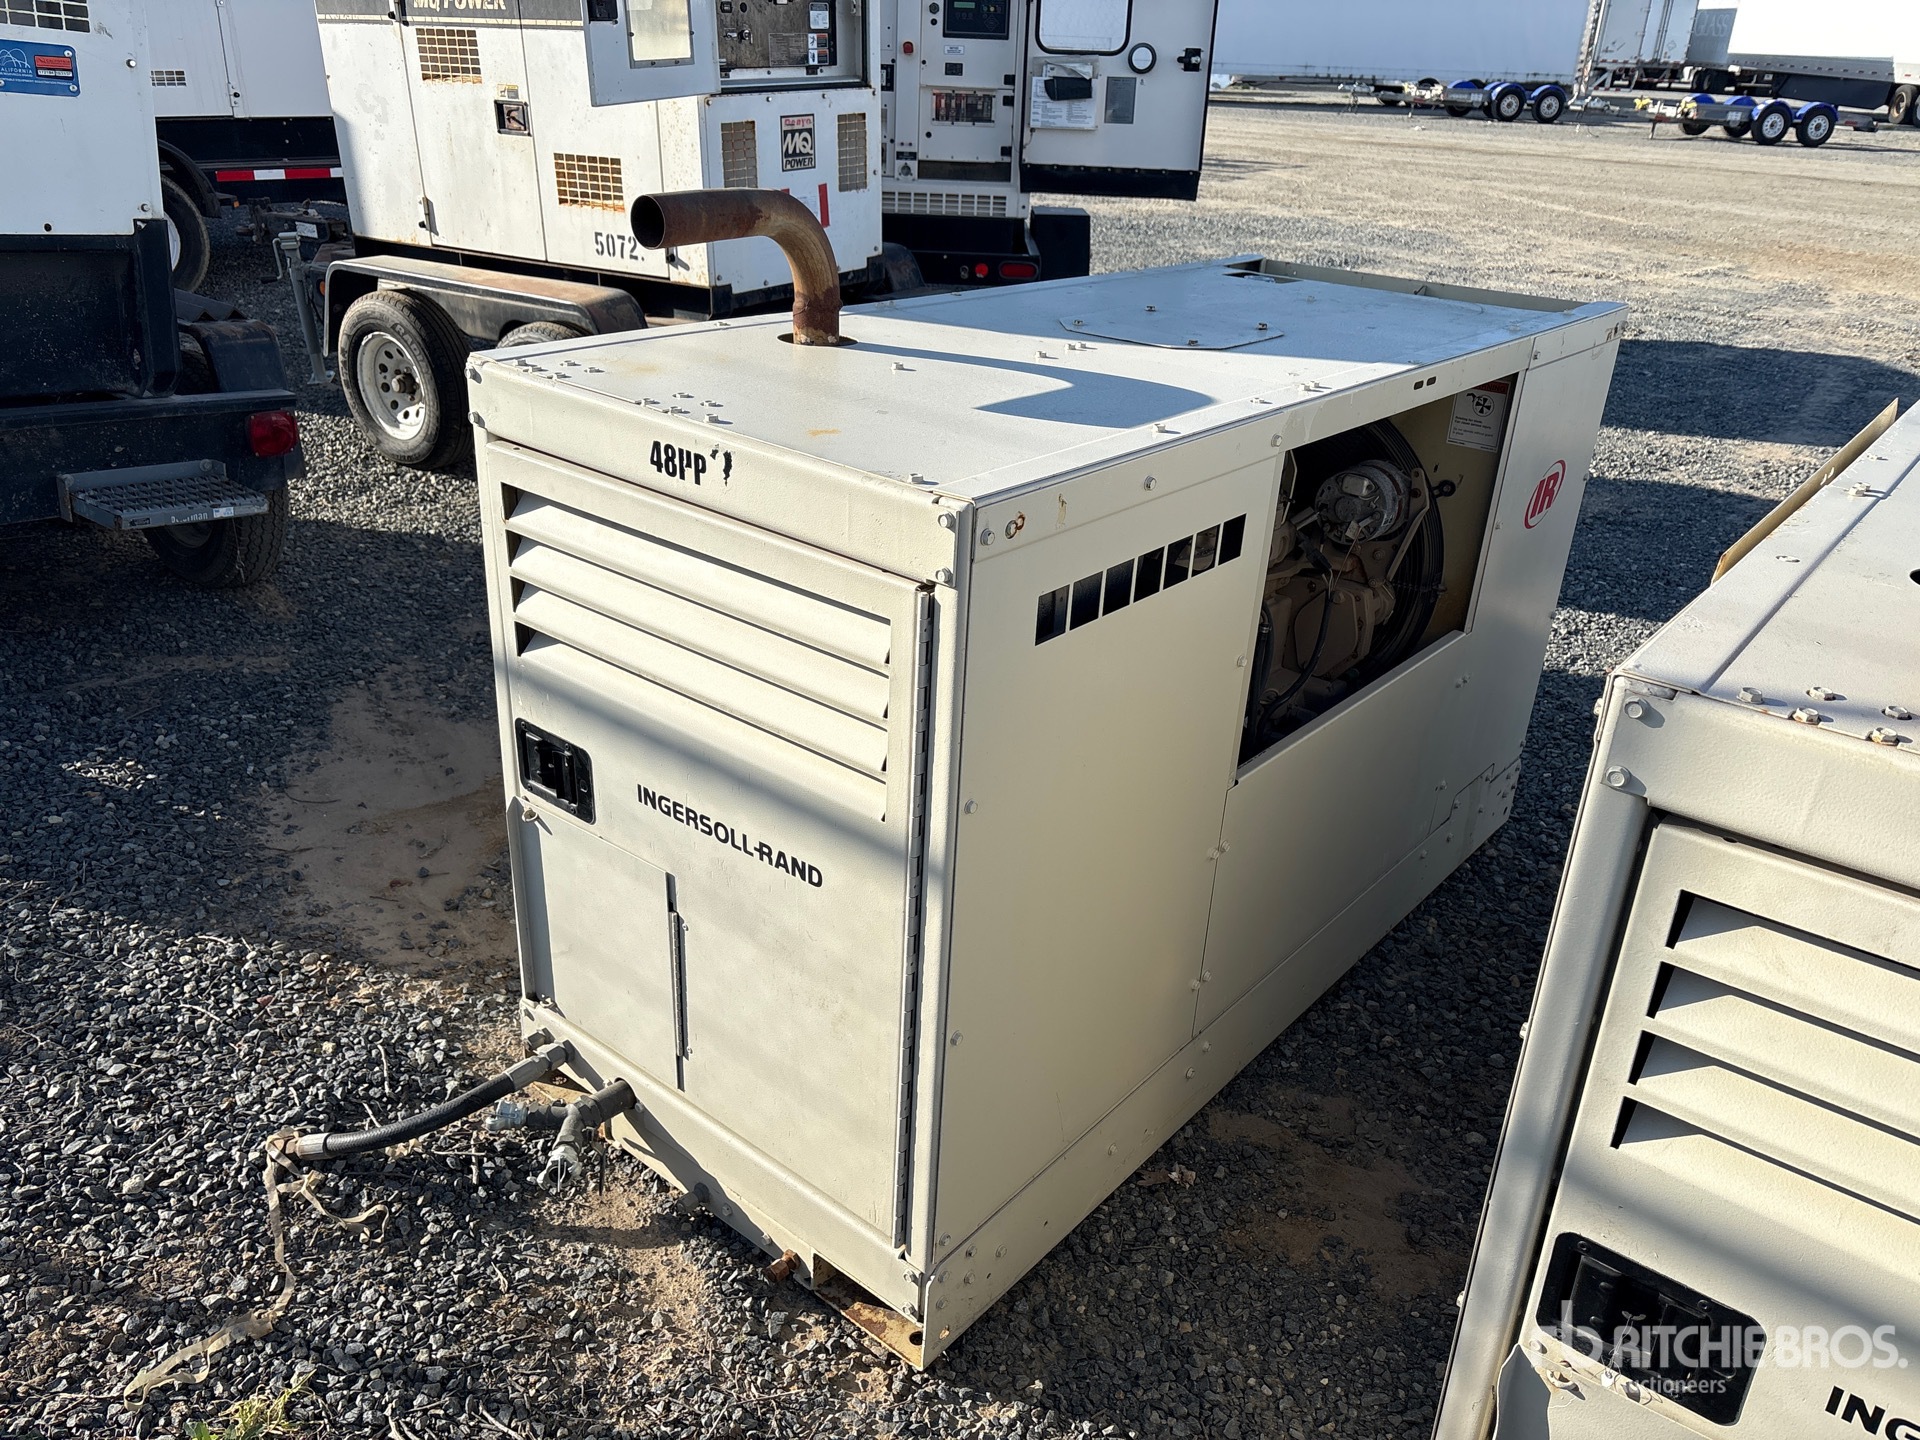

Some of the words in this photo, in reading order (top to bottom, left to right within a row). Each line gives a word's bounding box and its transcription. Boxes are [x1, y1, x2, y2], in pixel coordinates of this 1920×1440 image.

[783, 131, 813, 155] MQ
[785, 157, 814, 169] POWER
[1530, 471, 1560, 519] IR
[637, 783, 824, 888] INGERSOLL-RAND
